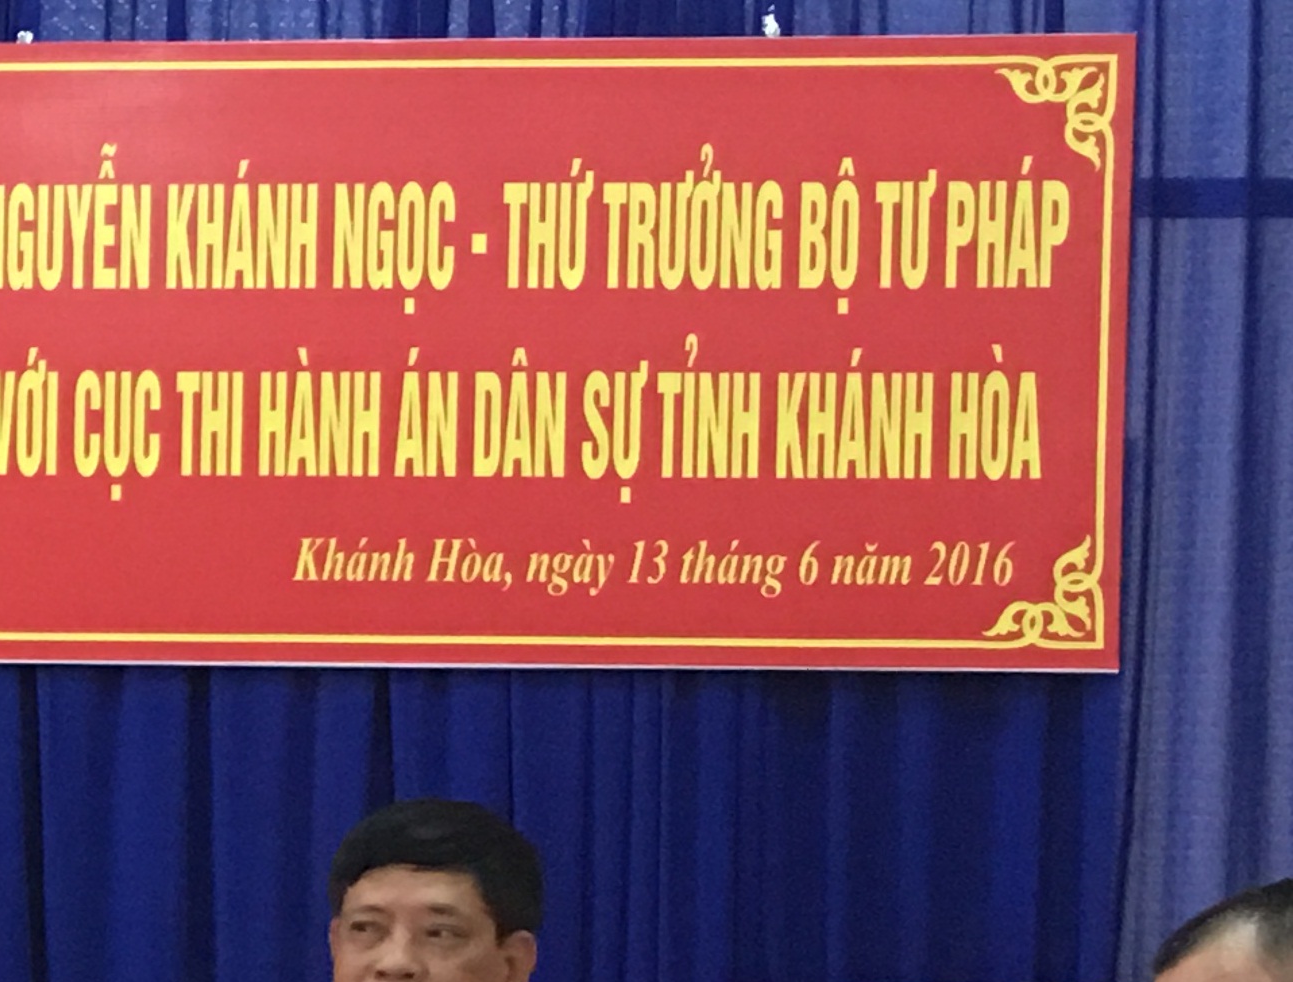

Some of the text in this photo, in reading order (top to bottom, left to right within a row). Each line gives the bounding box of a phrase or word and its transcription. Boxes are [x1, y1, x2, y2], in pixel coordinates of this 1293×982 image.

[165, 158, 319, 291] KHÁNH
[332, 180, 456, 315] NGỌC
[470, 232, 488, 255] -
[503, 157, 595, 291] THỨ
[602, 142, 784, 291] TRƯỞNG
[798, 156, 860, 315] BỘ
[875, 168, 938, 290] TƯ
[945, 155, 1070, 289] PHÁP
[73, 369, 162, 502] CỤC
[176, 370, 244, 478] THI
[258, 346, 382, 478] HÀNH
[393, 346, 459, 478] ÁN
[472, 346, 567, 478] DÂN
[581, 359, 649, 504] SỰ
[657, 333, 761, 480] TỈNH
[775, 347, 934, 480] KHÁNH
[948, 343, 1042, 481] HÒA
[292, 536, 1015, 599] Khánh Hòa, ngày 13 tháng 6 năm 2016
